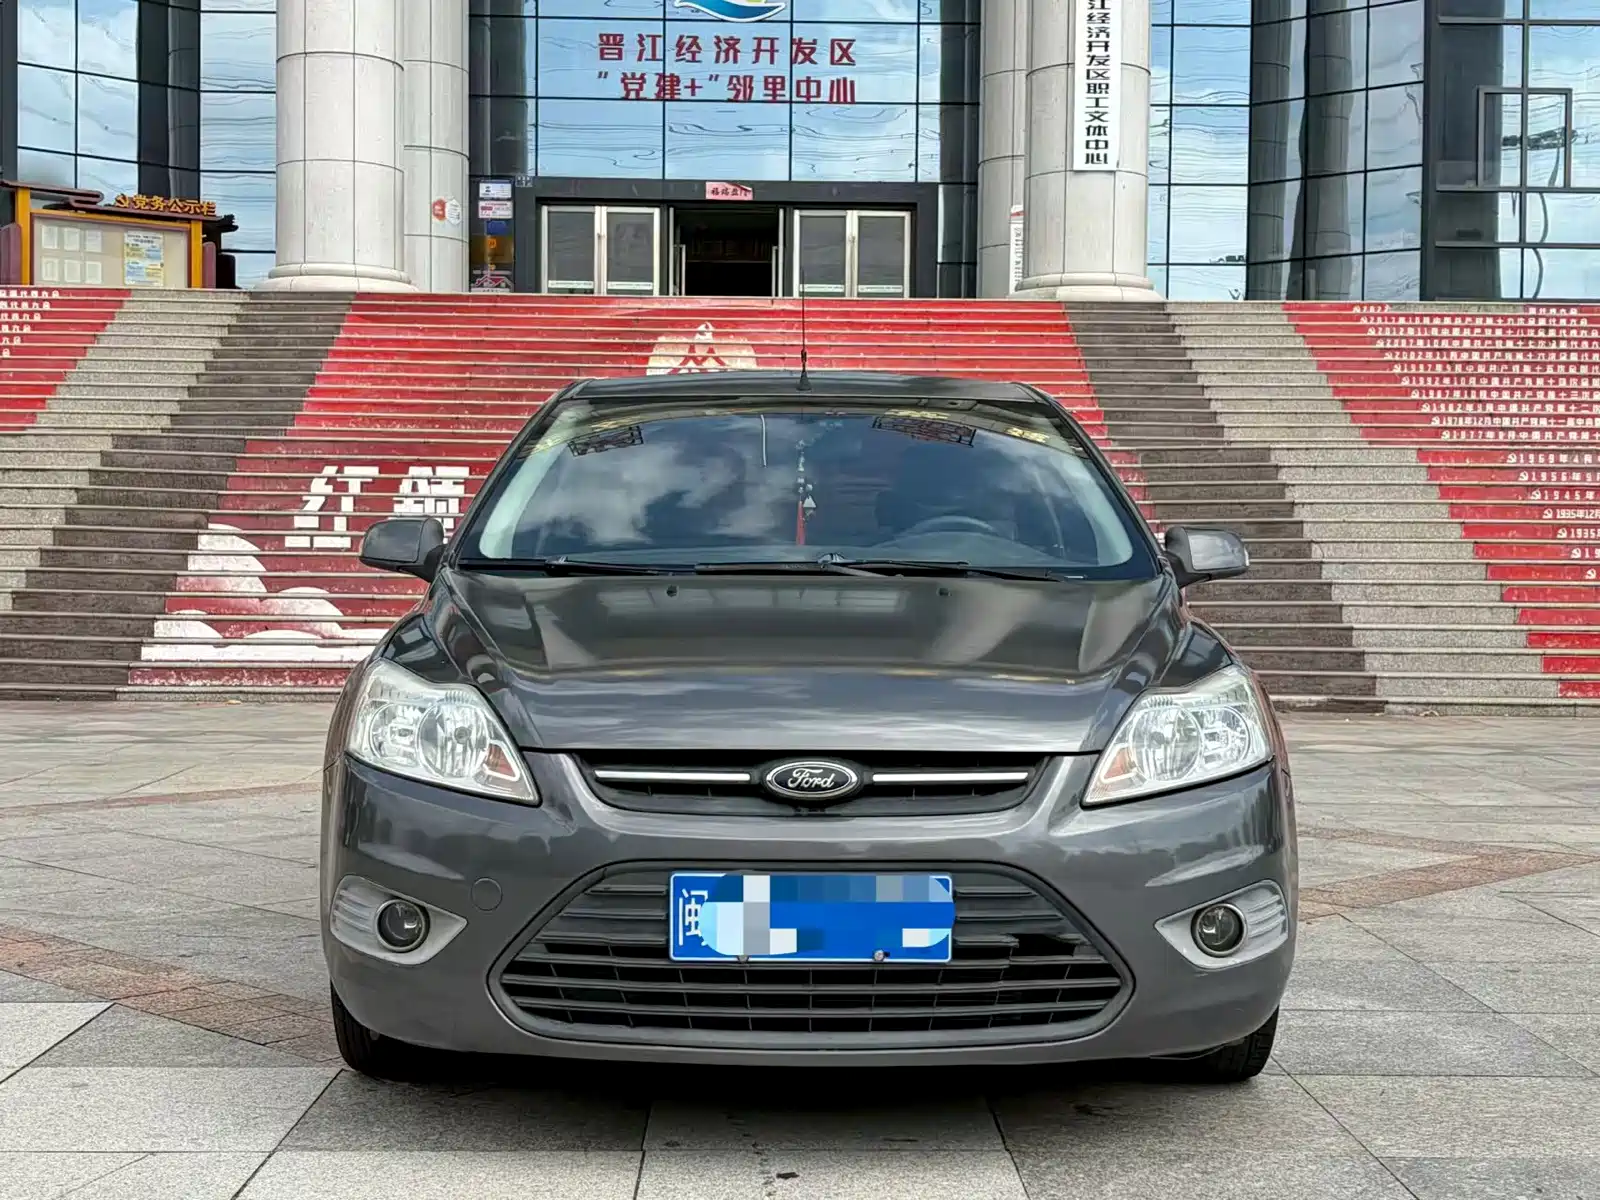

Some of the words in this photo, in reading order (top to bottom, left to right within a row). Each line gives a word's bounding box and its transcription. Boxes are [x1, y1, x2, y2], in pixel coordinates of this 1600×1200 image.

[598, 33, 857, 66] 晋江经济开发区
[1085, 0, 1111, 165] 江经济开发区职工文体中心
[133, 193, 217, 217] 党务公示栏
[787, 768, 836, 788] Ford
